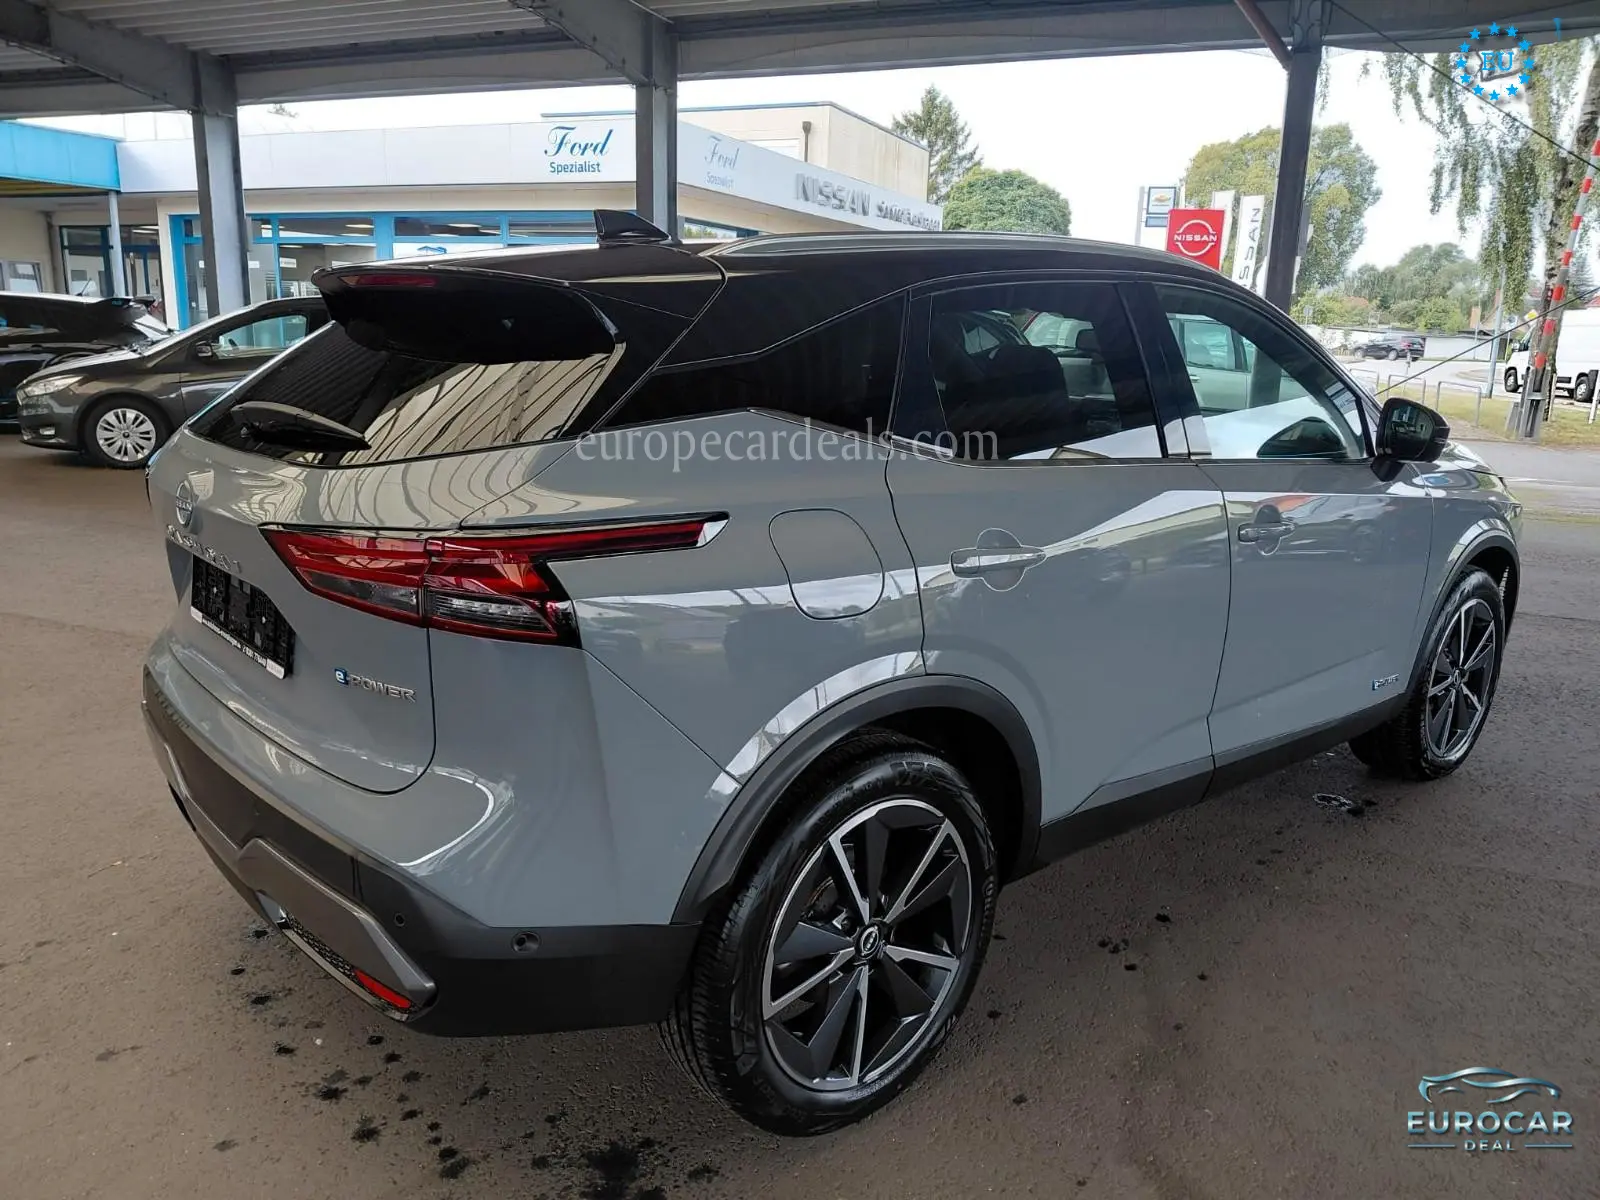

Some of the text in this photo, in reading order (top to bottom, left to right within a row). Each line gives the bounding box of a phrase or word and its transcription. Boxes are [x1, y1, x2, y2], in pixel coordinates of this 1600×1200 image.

[544, 126, 613, 156] Ford
[549, 161, 602, 175] Spezialist
[796, 173, 872, 216] NISSAN
[1174, 233, 1218, 242] NISSAN
